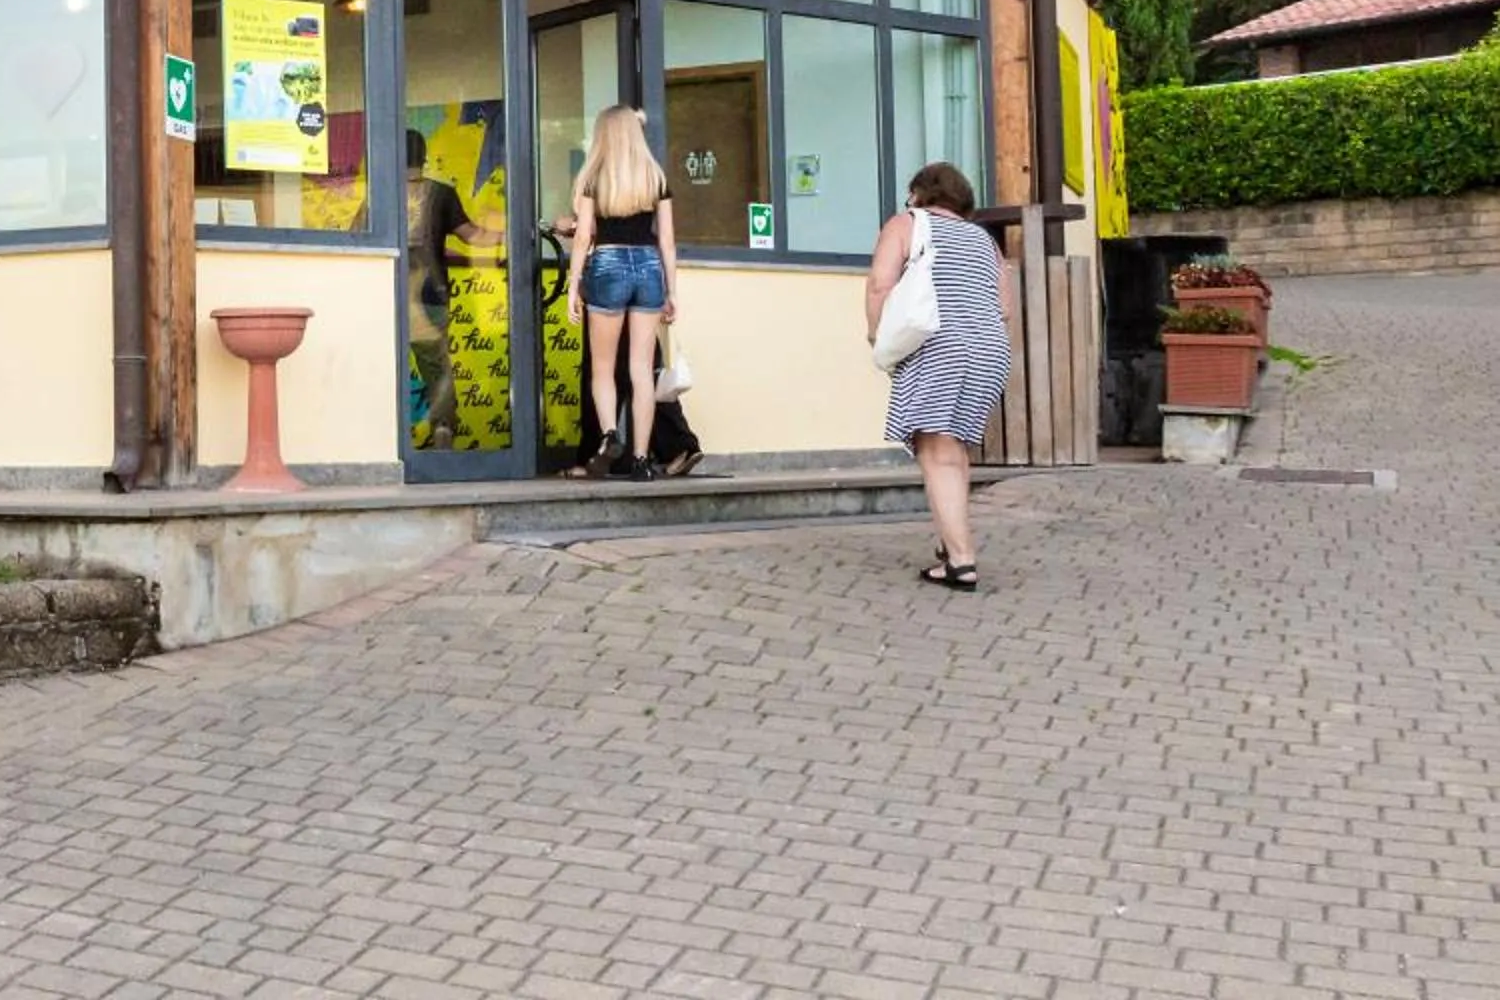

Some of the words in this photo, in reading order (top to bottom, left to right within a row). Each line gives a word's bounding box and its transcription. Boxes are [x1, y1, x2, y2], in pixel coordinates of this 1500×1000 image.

[462, 327, 494, 352] hu
[548, 327, 580, 351] hu
[461, 384, 493, 408] hu
